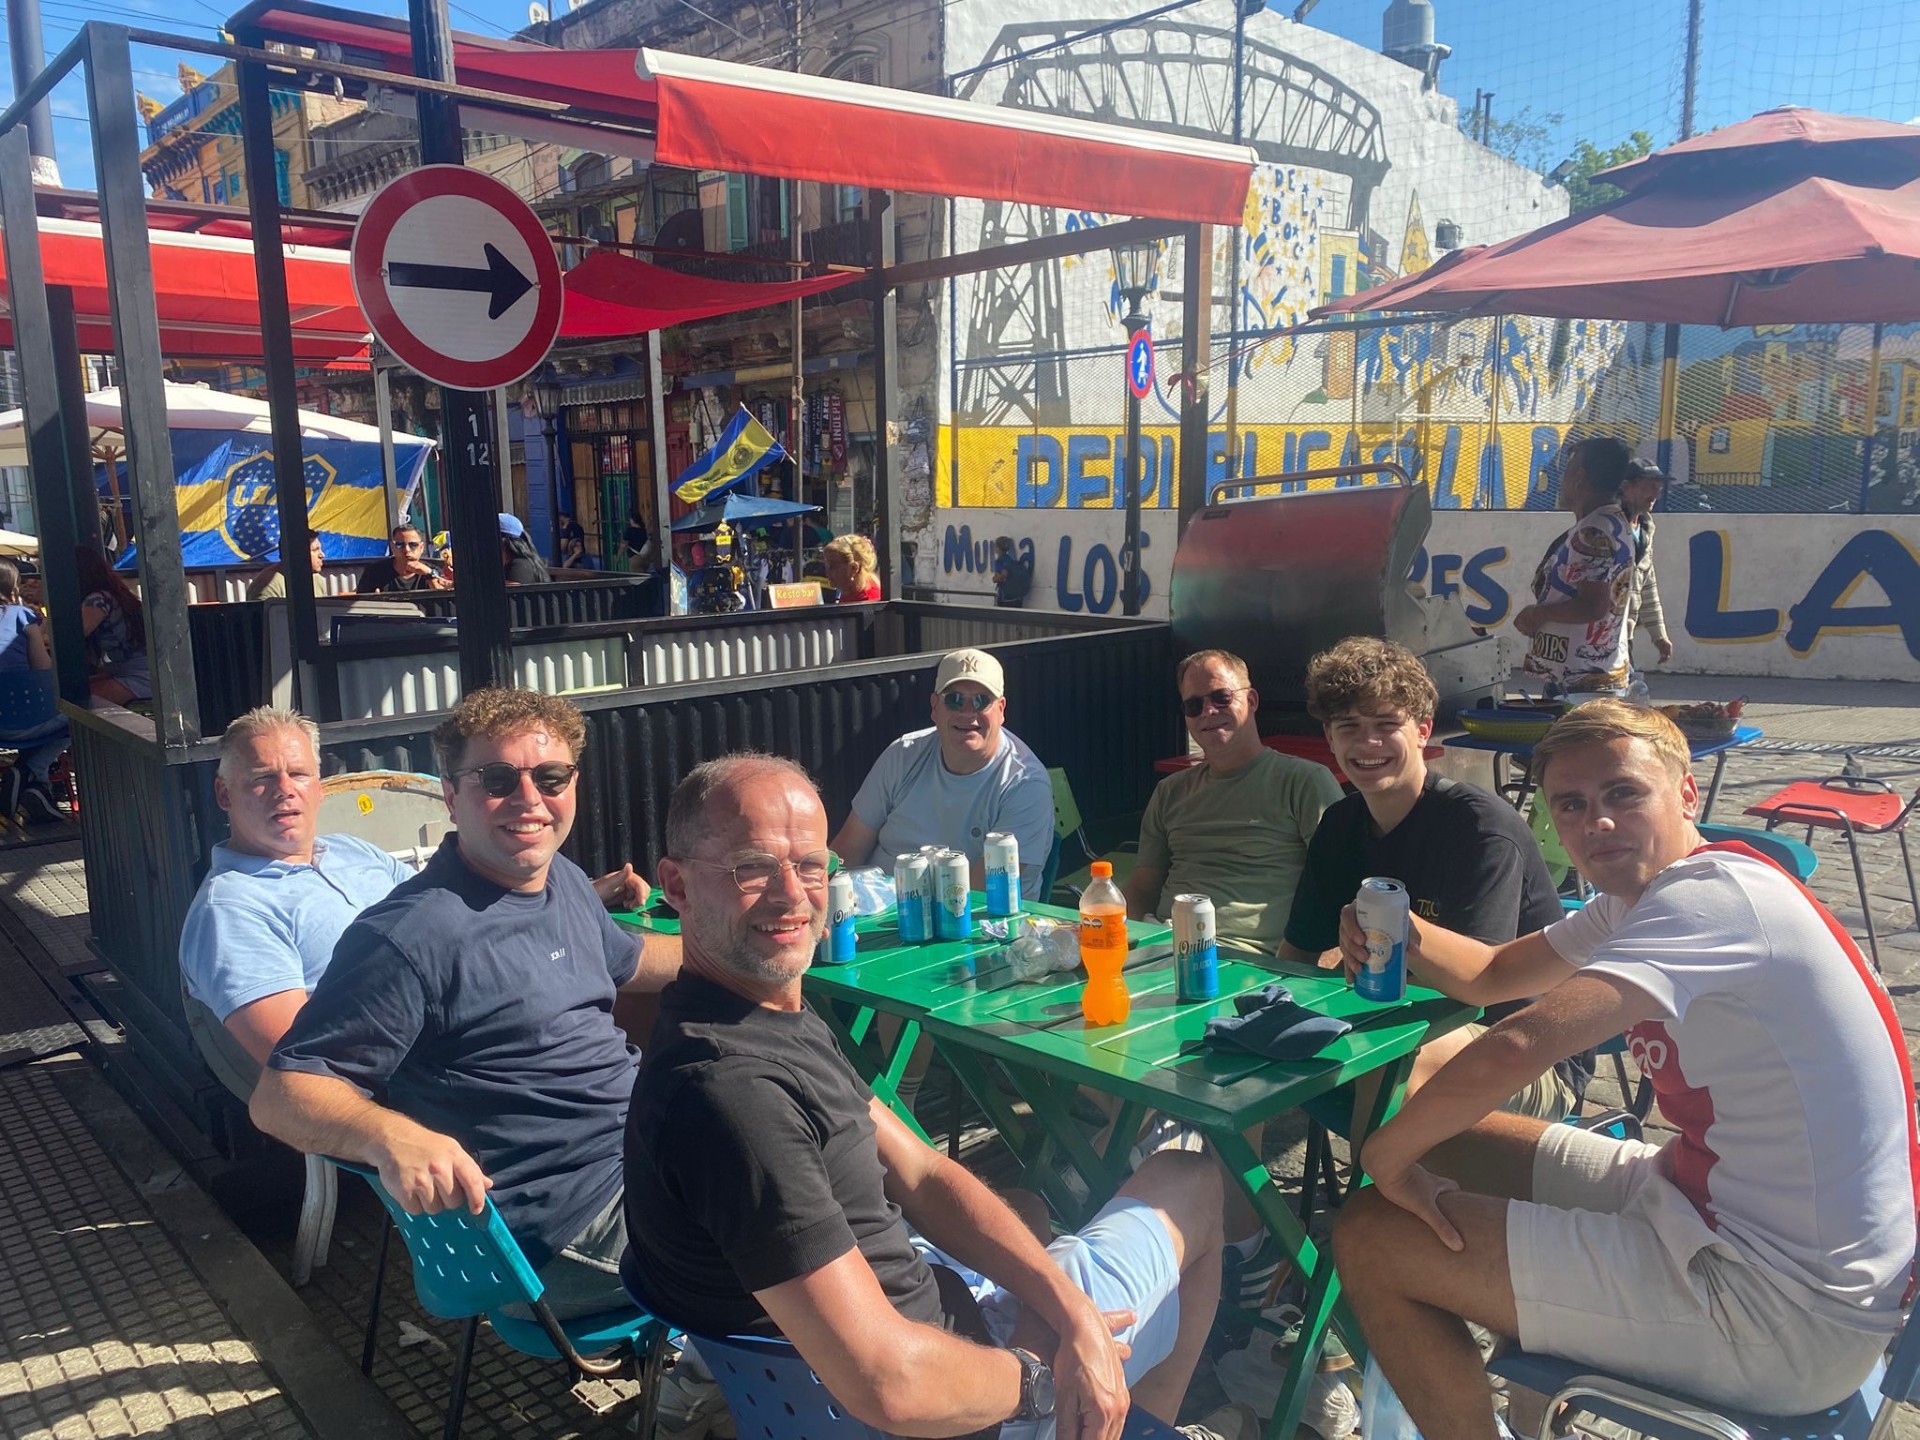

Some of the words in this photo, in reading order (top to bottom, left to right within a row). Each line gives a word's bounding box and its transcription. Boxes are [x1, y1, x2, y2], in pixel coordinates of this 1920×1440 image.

[1274, 168, 1296, 193] DE
[466, 442, 490, 466] 12
[944, 524, 1035, 576] Mua
[1684, 529, 1920, 665] LA
